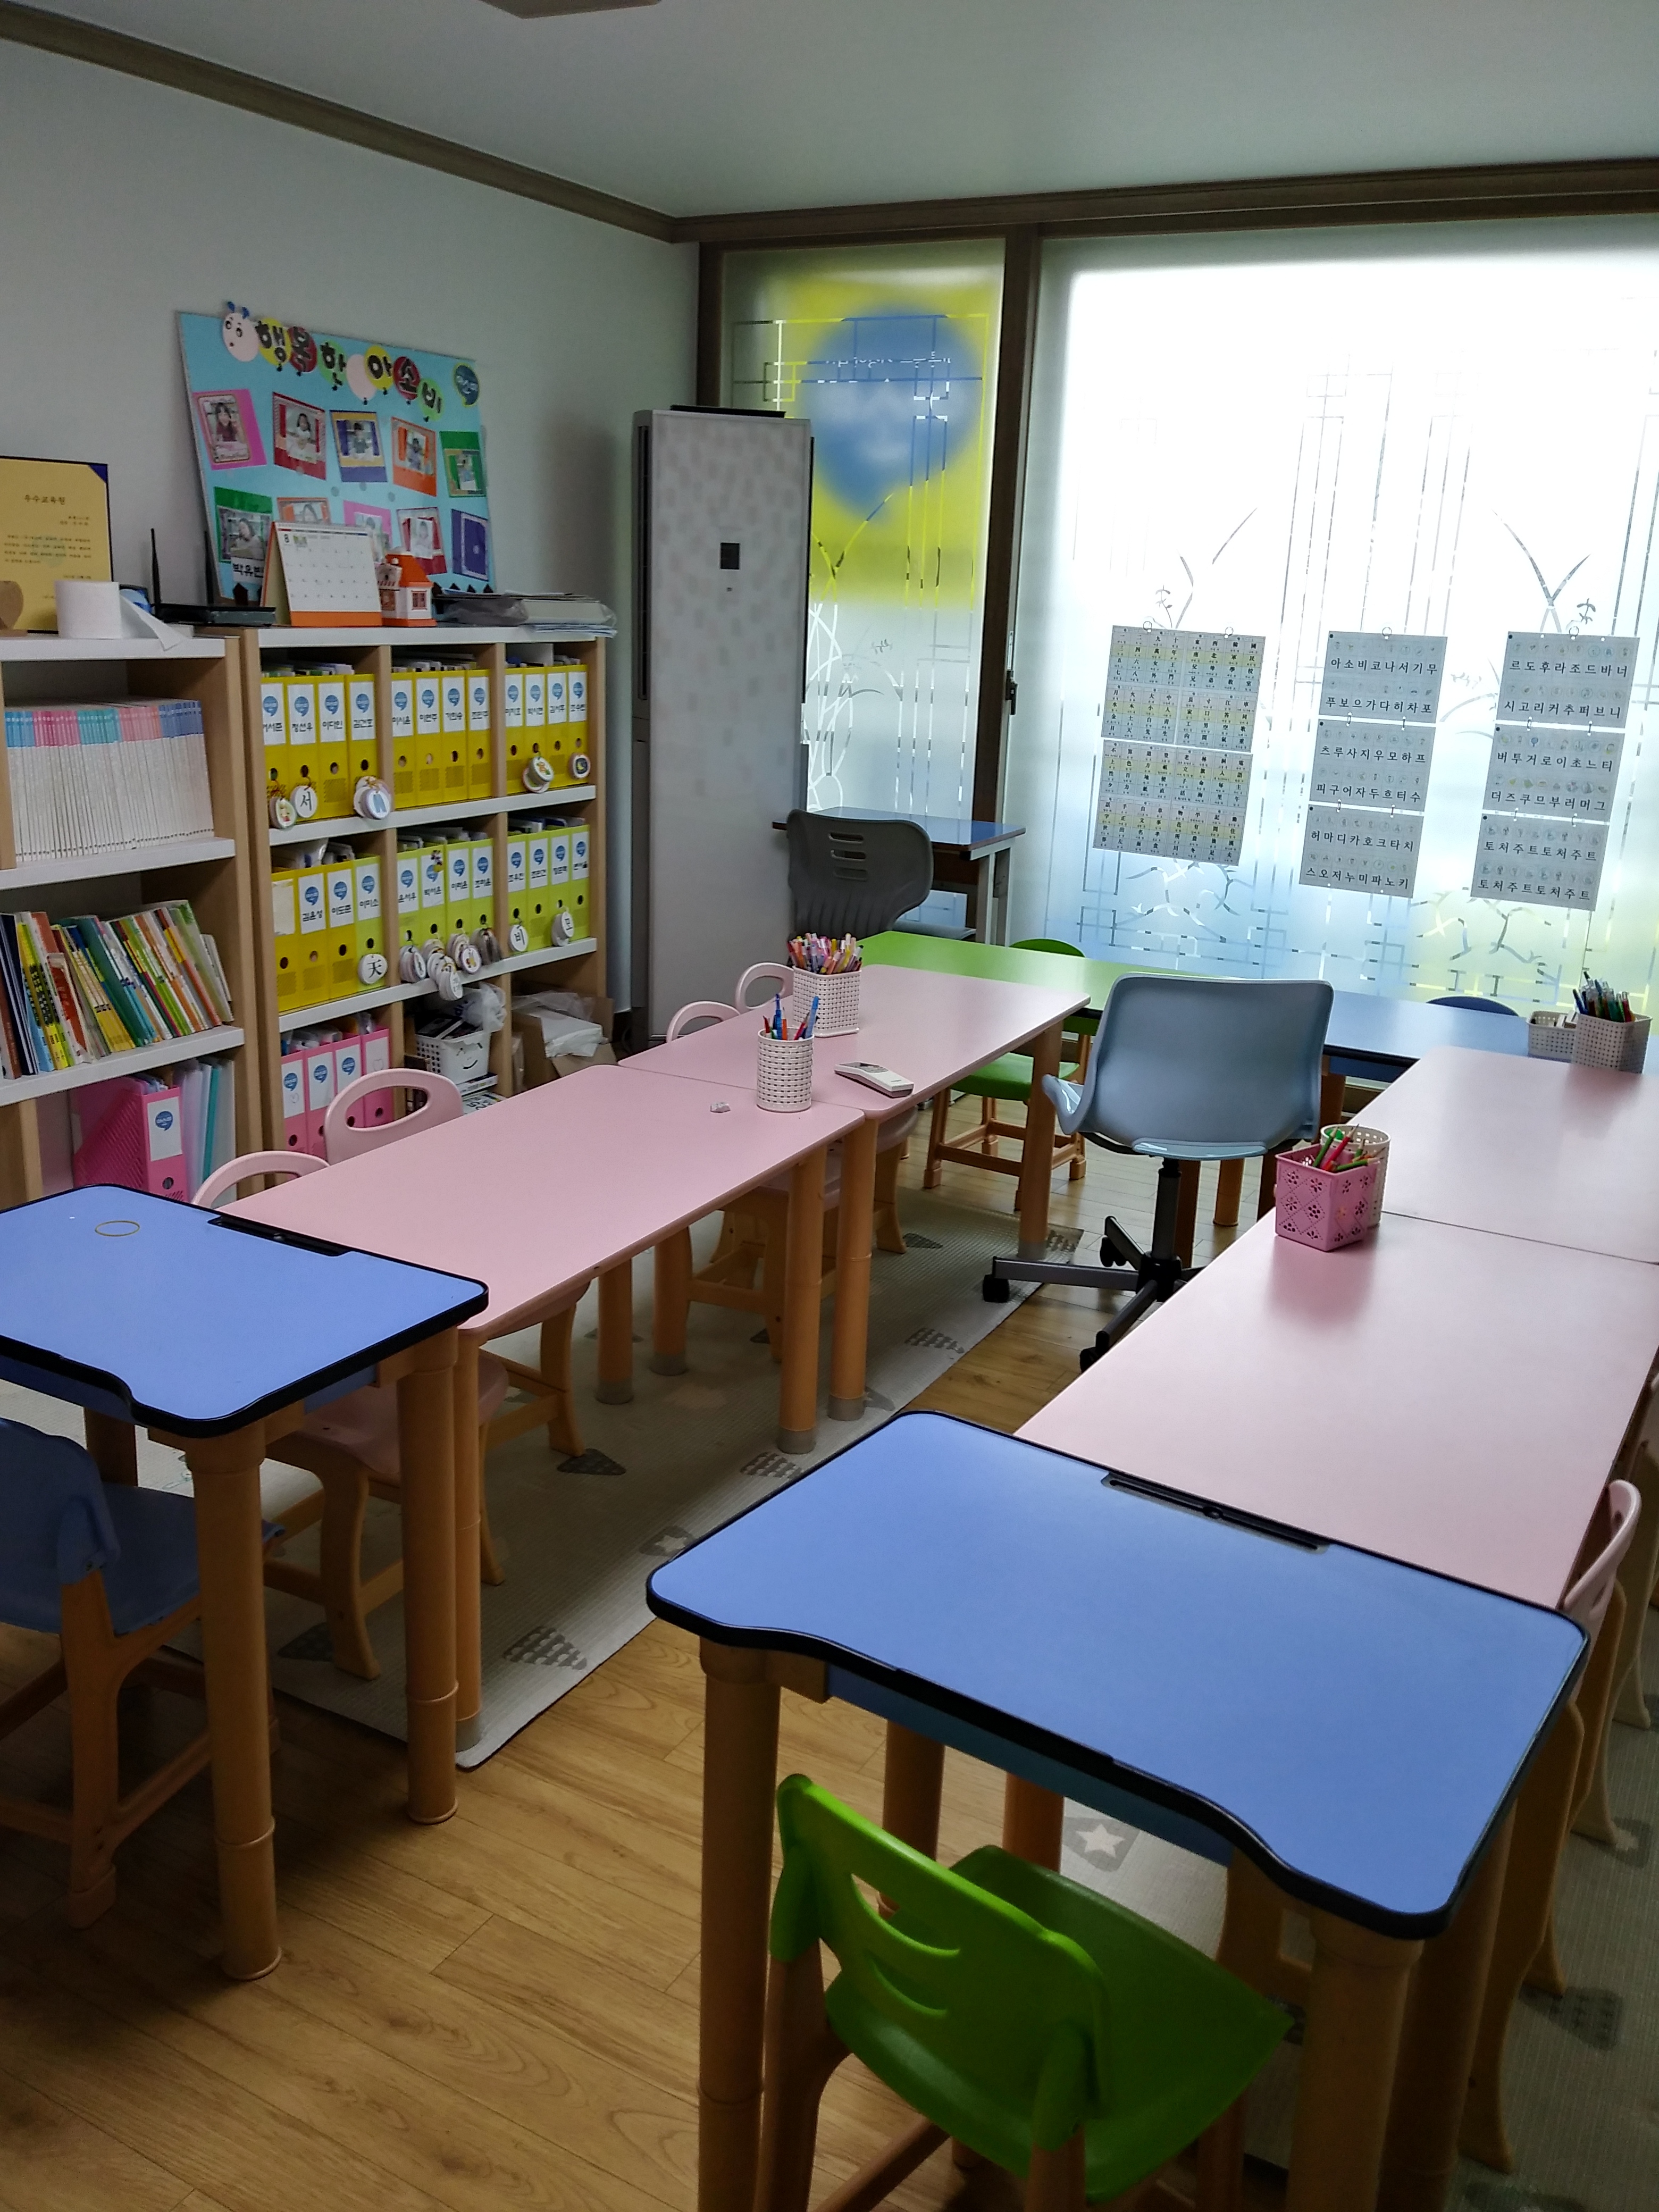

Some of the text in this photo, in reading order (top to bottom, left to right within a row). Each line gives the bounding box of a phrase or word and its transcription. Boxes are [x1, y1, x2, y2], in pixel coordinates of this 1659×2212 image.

[255, 321, 442, 413] 행복한 아소비
[1331, 658, 1341, 669] 아
[1358, 660, 1367, 671] 비
[1371, 661, 1381, 670] 코
[1386, 661, 1395, 672] 나
[1398, 662, 1408, 673] 서
[1413, 663, 1422, 674] 기
[1427, 664, 1437, 675] 무
[1510, 661, 1627, 677] 르 도 후 라 조 드 바 너
[1326, 697, 1336, 707] 푸
[1339, 699, 1349, 707] 보
[1366, 700, 1376, 710] 가
[1380, 700, 1390, 711] 다
[1394, 701, 1403, 713] 히
[1407, 702, 1418, 713] 차
[1421, 705, 1431, 713] 포
[1504, 701, 1620, 718] 시 고 리 커 추 퍼 브 니
[1320, 746, 1330, 755] 츠
[1334, 747, 1343, 757] 루
[1347, 748, 1357, 759] 사
[1360, 749, 1369, 760] 지
[1374, 750, 1384, 760] 우
[1402, 752, 1412, 763] 하
[1498, 752, 1507, 763] 버
[1511, 753, 1522, 764] 투
[1527, 755, 1536, 765] 거
[1540, 756, 1551, 765] 로
[1557, 757, 1566, 768] 이
[1571, 758, 1581, 767] 초
[1602, 760, 1612, 772] 티
[300, 791, 312, 811] 서
[1317, 784, 1420, 802] 피 구 어 자 두 흐 터 수
[1492, 791, 1501, 802] 더
[1520, 794, 1530, 805] 쿠
[1534, 796, 1545, 805] 므
[1549, 797, 1560, 808] 부
[1565, 798, 1575, 809] 러
[1580, 799, 1590, 810] 머
[1594, 801, 1605, 810] 그
[1312, 831, 1320, 841] 허
[1325, 832, 1334, 843] 마
[1337, 834, 1346, 844] 디
[1350, 835, 1360, 845] 카
[1363, 837, 1372, 846] 호
[1390, 840, 1400, 850] 타
[1404, 841, 1413, 852] 치
[1484, 842, 1596, 860] 토 처 주 트 토 처 주 트
[1319, 869, 1328, 878] 오
[1333, 870, 1341, 881] 저
[1345, 873, 1355, 882] 누
[1359, 874, 1368, 884] 미
[1371, 875, 1381, 885] 파
[1385, 877, 1395, 886] 노
[1399, 878, 1408, 889] 키
[1478, 880, 1589, 900] 토 처 주 트 토 처 주 트
[514, 927, 525, 945] 비
[367, 960, 382, 978] 天
